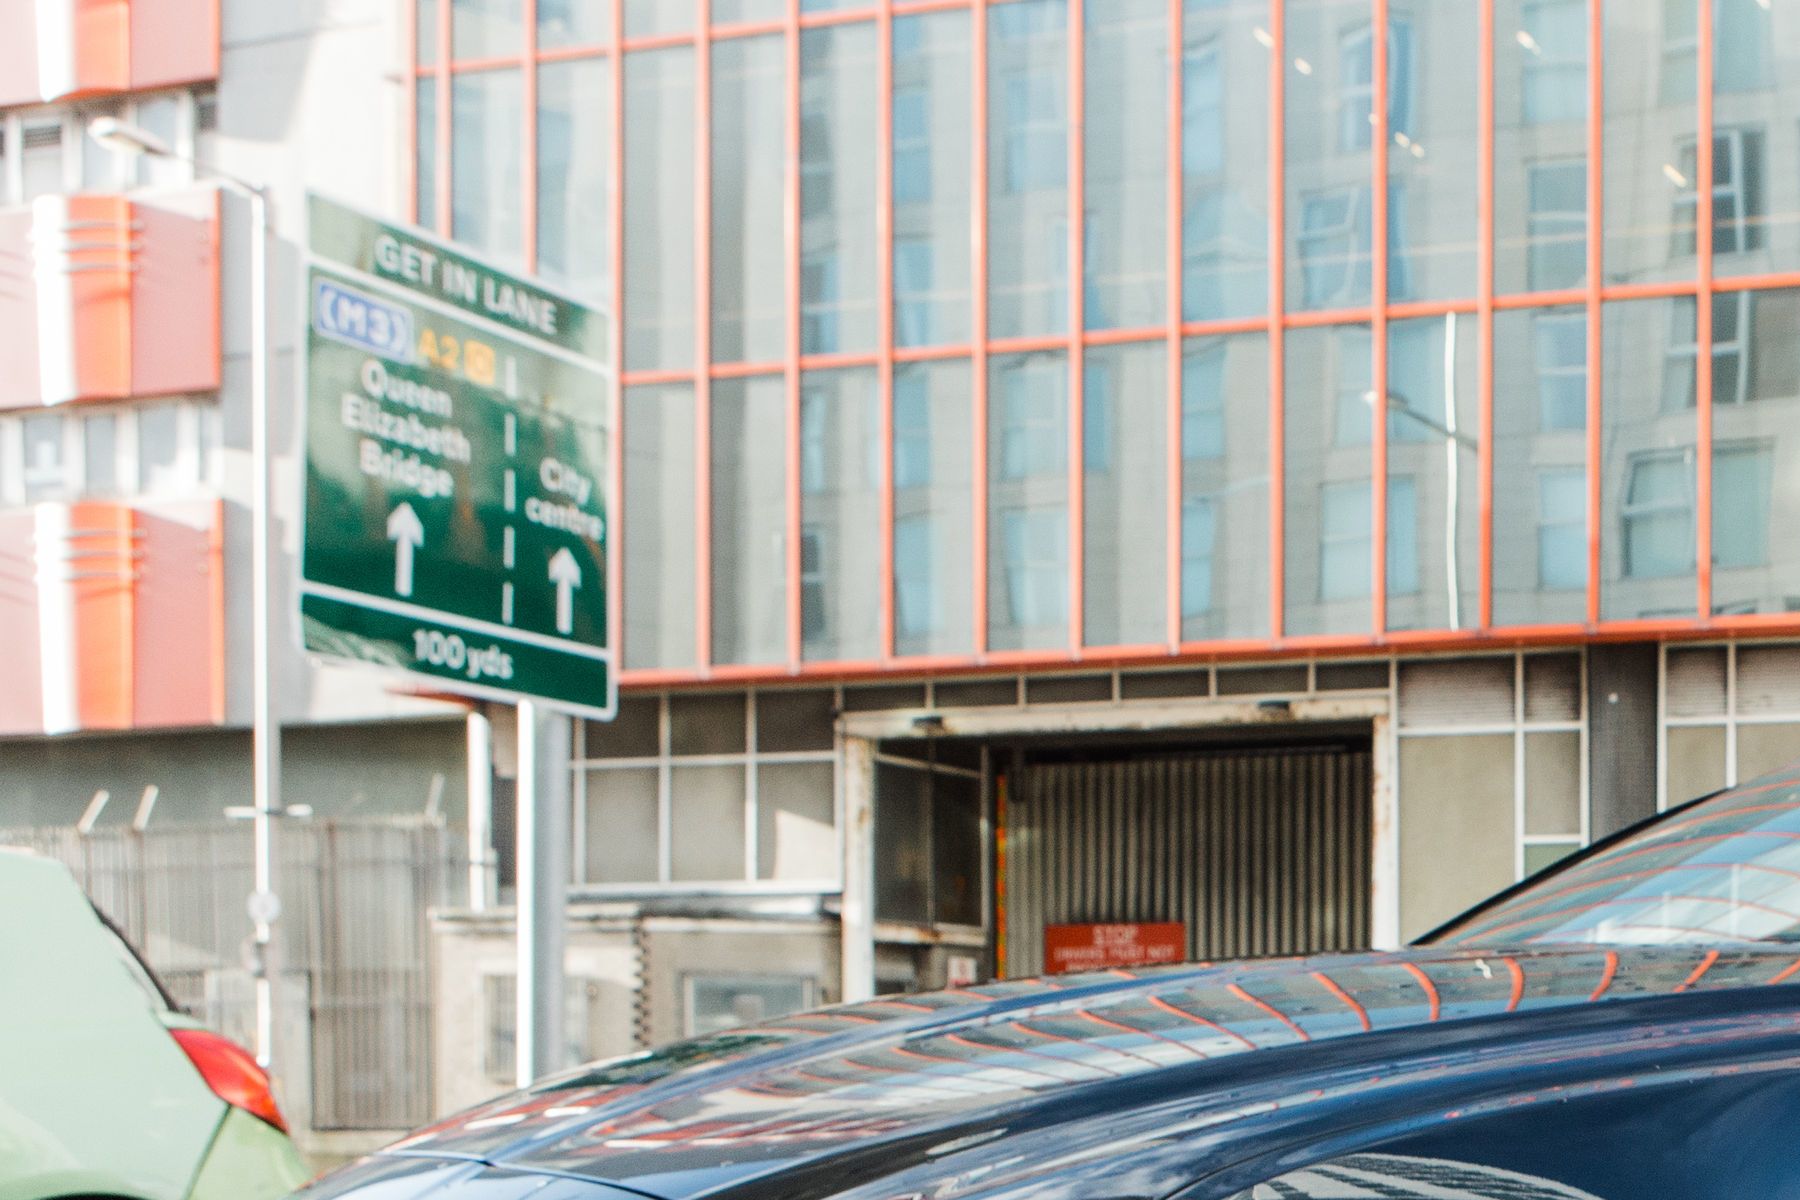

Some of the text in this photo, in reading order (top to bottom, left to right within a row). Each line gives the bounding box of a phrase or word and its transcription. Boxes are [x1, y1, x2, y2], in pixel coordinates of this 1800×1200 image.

[374, 234, 558, 335] GET IN LANE
[320, 289, 458, 369] (M3) A2
[361, 358, 453, 418] Queen
[341, 392, 471, 463] Elizabeth
[360, 437, 454, 498] Bridge
[540, 457, 591, 505] City
[525, 496, 604, 541] centre
[413, 630, 514, 679] 100 yds
